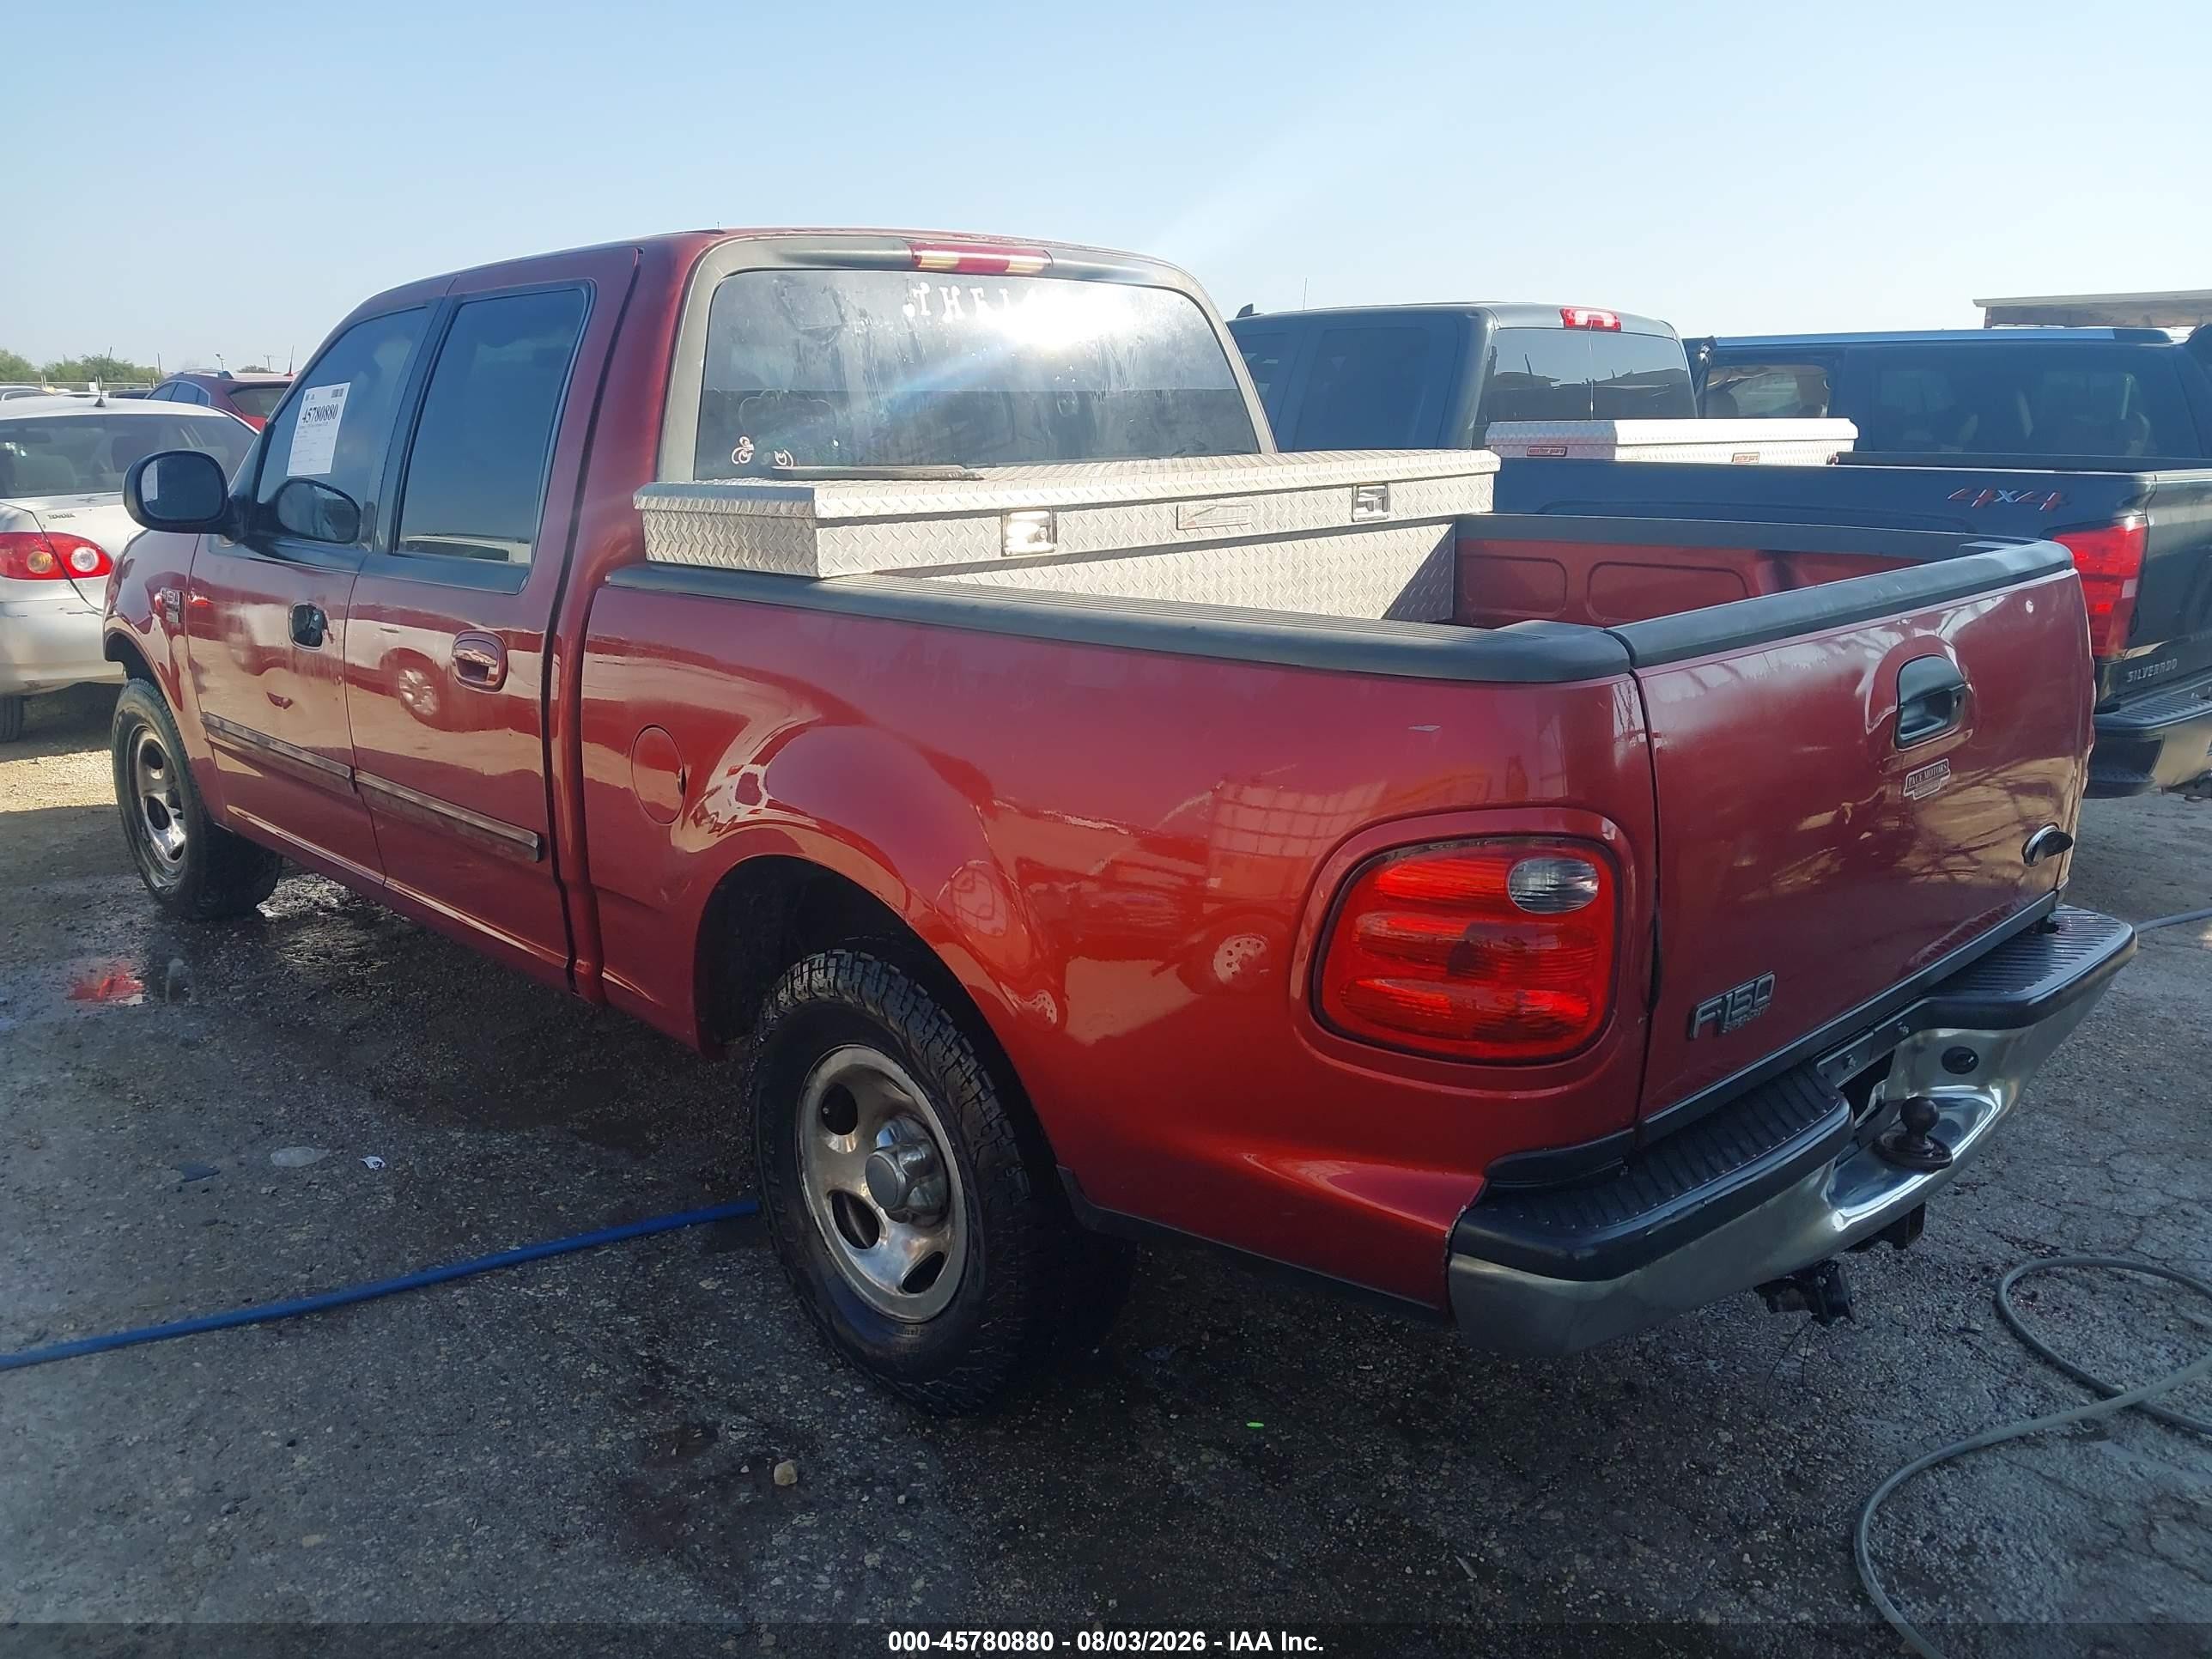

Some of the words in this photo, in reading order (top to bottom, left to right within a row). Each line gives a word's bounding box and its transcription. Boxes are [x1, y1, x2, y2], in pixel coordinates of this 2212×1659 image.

[302, 404, 338, 422] 45780880
[2126, 658, 2178, 684] SILVERADO
[1923, 763, 1948, 779] MOTORS
